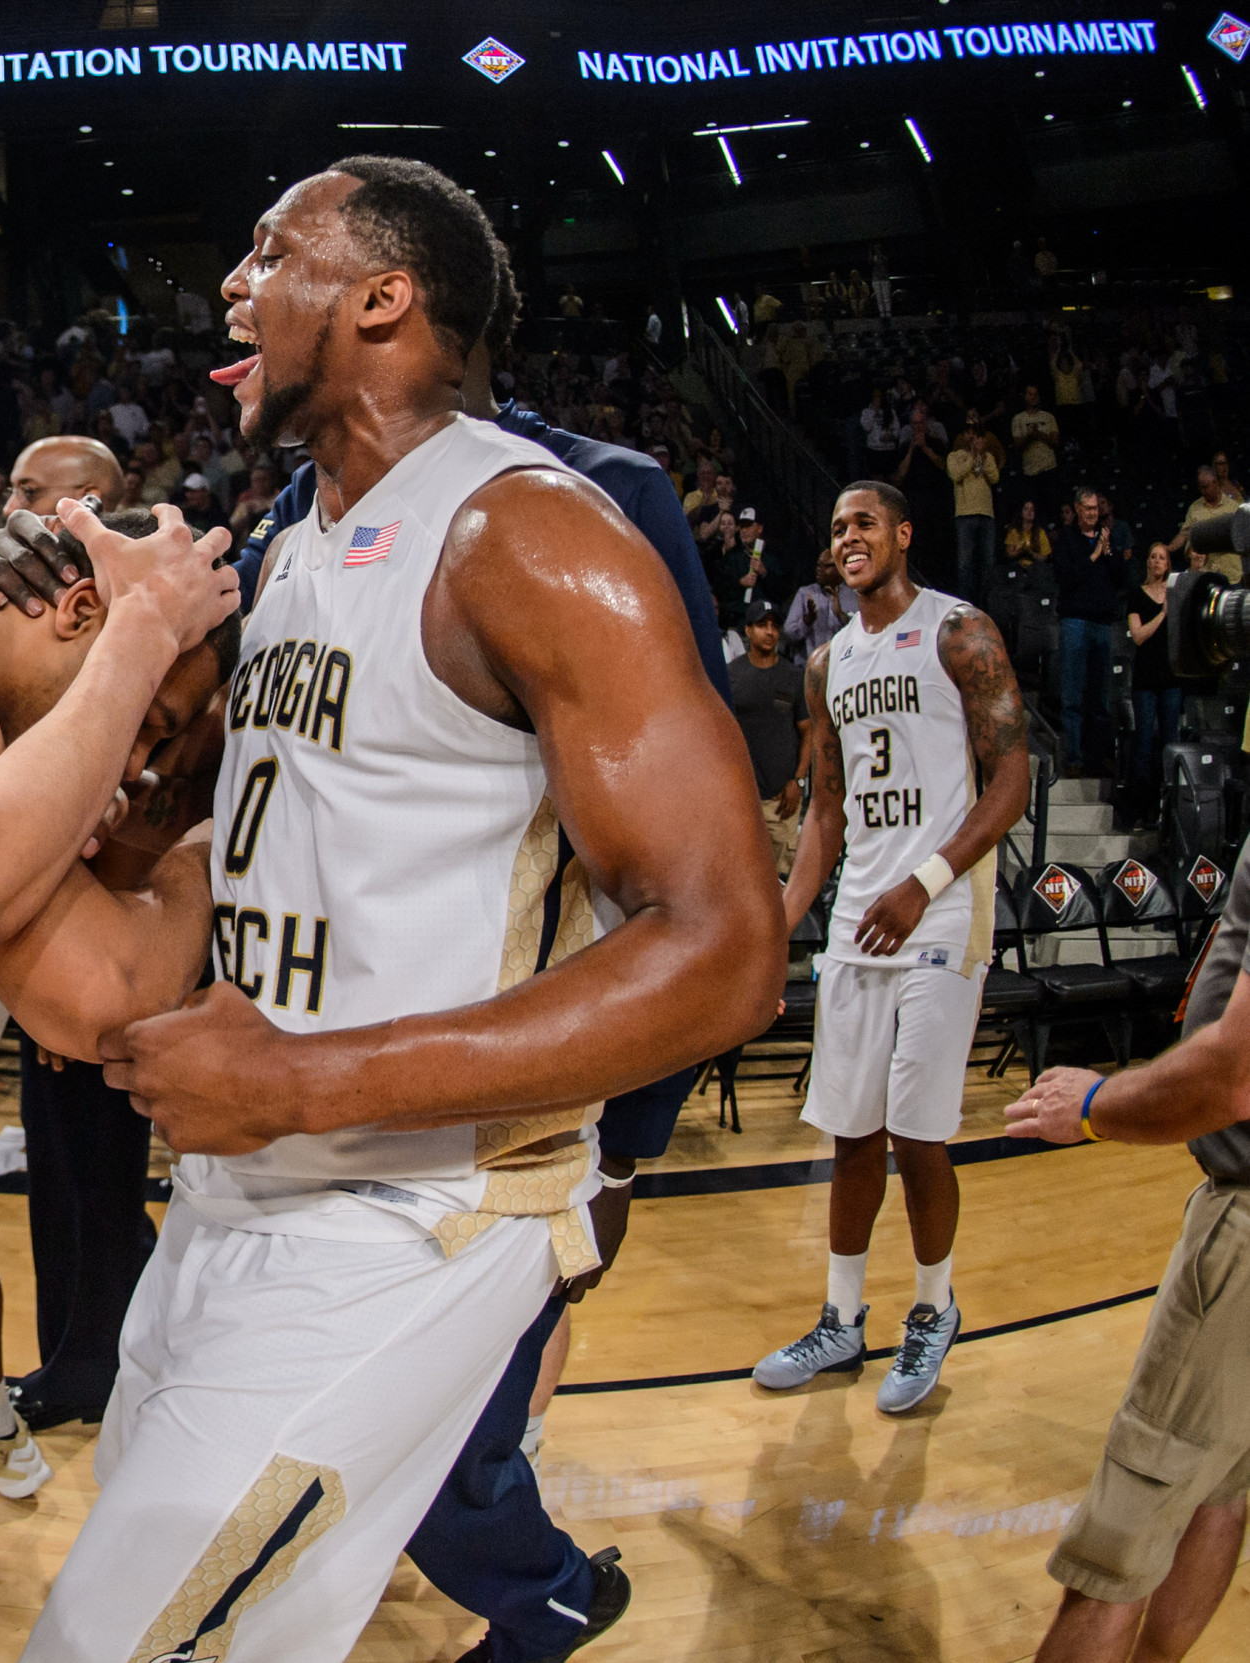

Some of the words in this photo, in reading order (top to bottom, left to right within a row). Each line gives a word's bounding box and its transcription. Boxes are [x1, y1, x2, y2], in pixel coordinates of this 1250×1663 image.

[148, 42, 407, 74] TOURNAMENT
[577, 49, 751, 84] NATIONAL
[754, 30, 941, 74] INVITATION
[943, 22, 1155, 58] TOURNAMENT
[230, 638, 353, 755] GEORGIA
[833, 675, 921, 731] GEORGIA
[869, 727, 891, 780] 3
[225, 755, 278, 880] 0
[1123, 875, 1146, 888] NIT
[1196, 873, 1216, 885] NIT
[214, 902, 329, 1016] ECH
